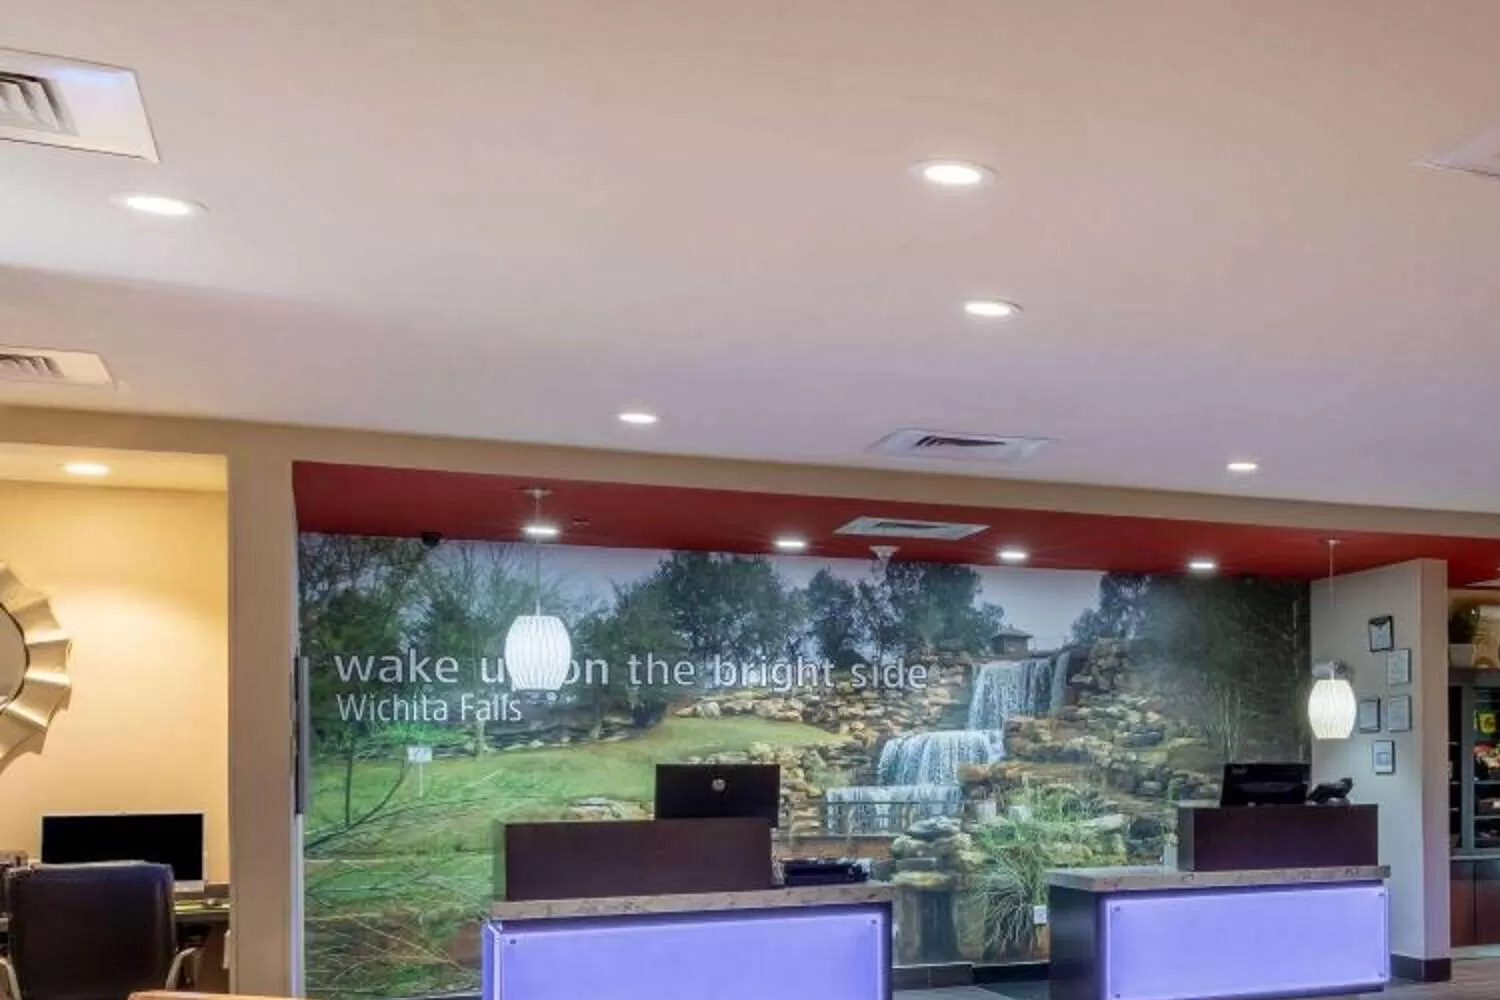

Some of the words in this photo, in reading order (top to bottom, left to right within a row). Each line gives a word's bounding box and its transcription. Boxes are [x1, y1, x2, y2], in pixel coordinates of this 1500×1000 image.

[334, 648, 459, 683] wake
[626, 652, 696, 685] the
[713, 653, 834, 692] bright
[851, 655, 927, 688] side
[335, 692, 449, 722] Wichita
[460, 692, 522, 722] Falls
